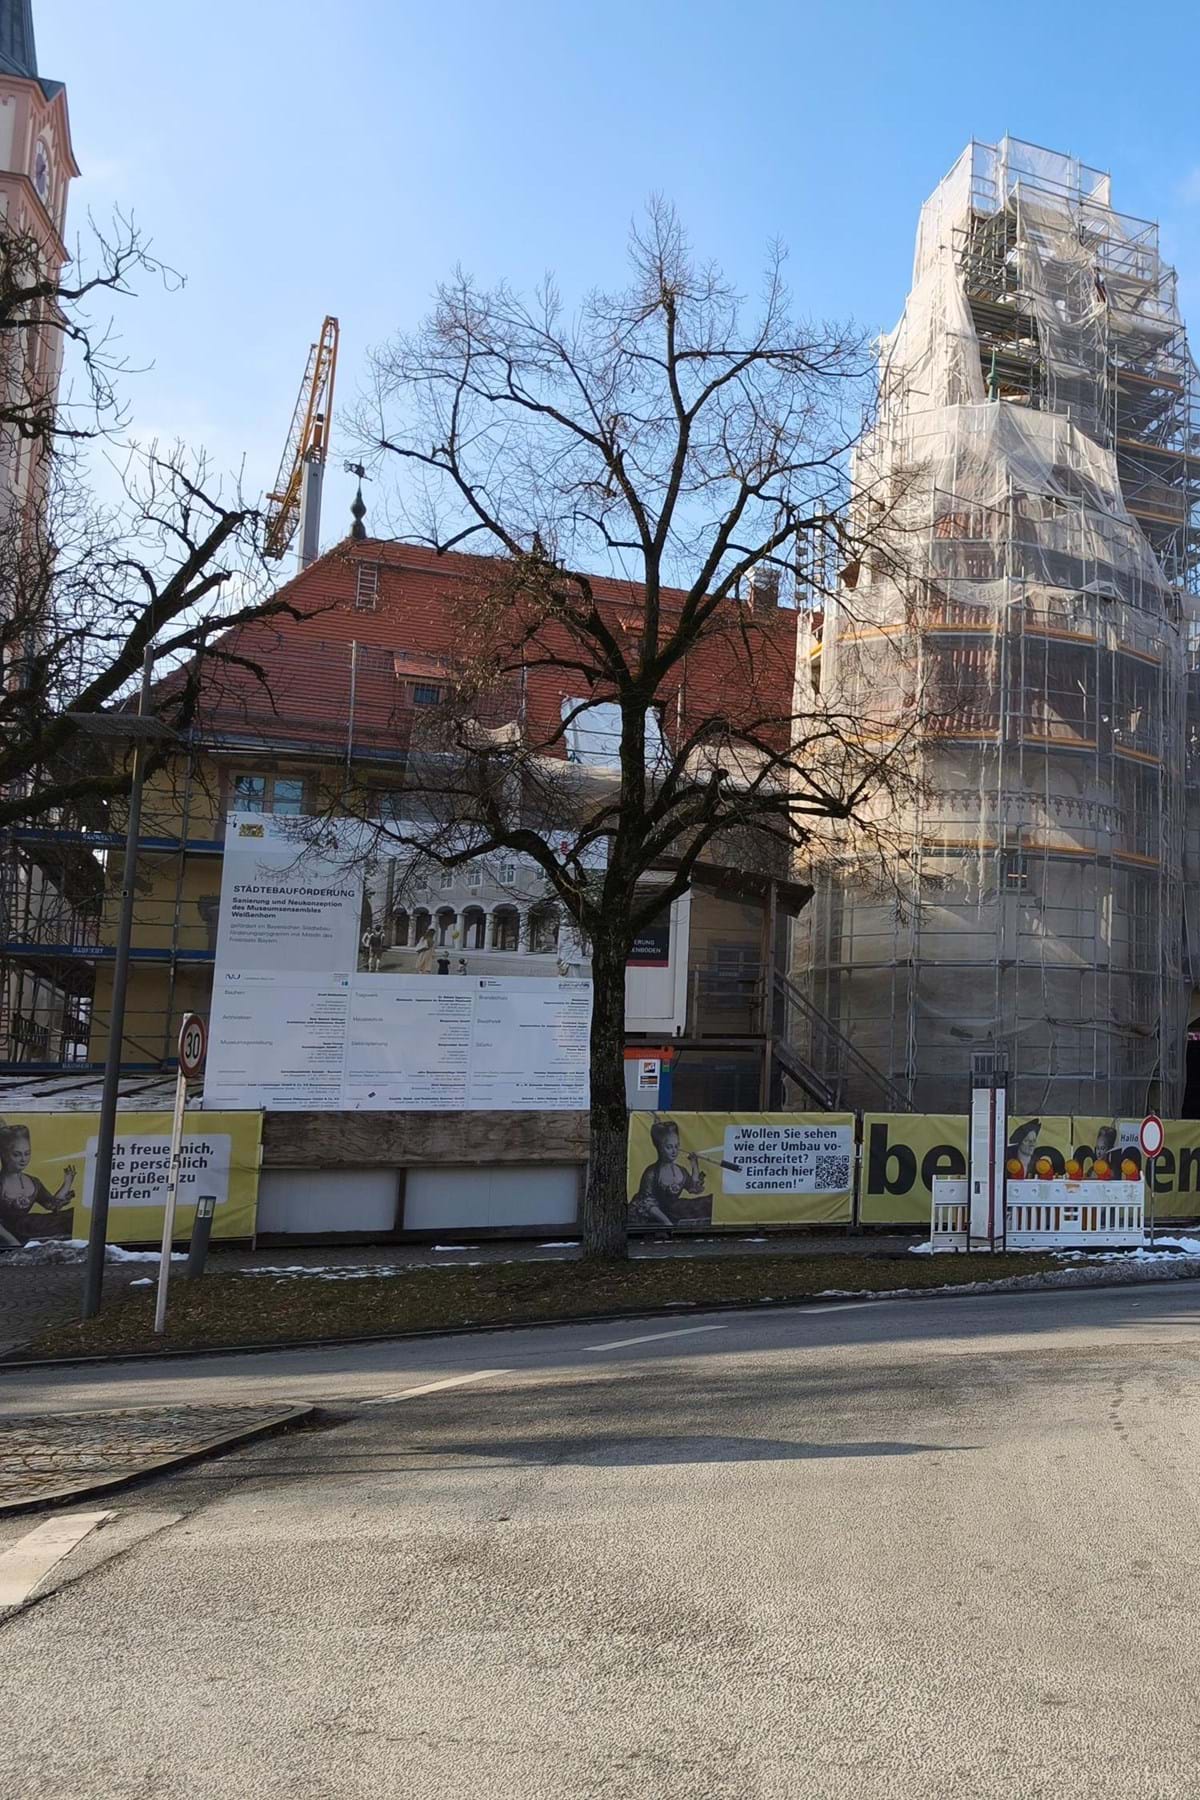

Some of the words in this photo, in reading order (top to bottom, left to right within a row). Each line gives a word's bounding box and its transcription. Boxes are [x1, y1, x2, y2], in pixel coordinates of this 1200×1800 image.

[233, 885, 355, 898] STÄDTEBAUFÖRDERUNG
[232, 897, 270, 905] Sanierung
[288, 899, 343, 908] Neukonzeption
[246, 905, 322, 913] Museumsensembles
[231, 911, 276, 919] Weißenhorn
[185, 1031, 200, 1059] 30
[734, 1128, 781, 1140] „Wollen
[784, 1128, 801, 1139] Sie
[804, 1128, 837, 1139] sehen
[130, 1143, 171, 1156] freue
[734, 1141, 757, 1152] wie
[758, 1141, 778, 1151] der
[781, 1141, 821, 1152] Umbau
[824, 1142, 842, 1152] vo-
[111, 1158, 126, 1170] ie
[733, 1153, 809, 1164] ranschreitet?
[746, 1166, 789, 1177] Einfach
[792, 1166, 815, 1177] hier
[179, 1174, 196, 1183] zu
